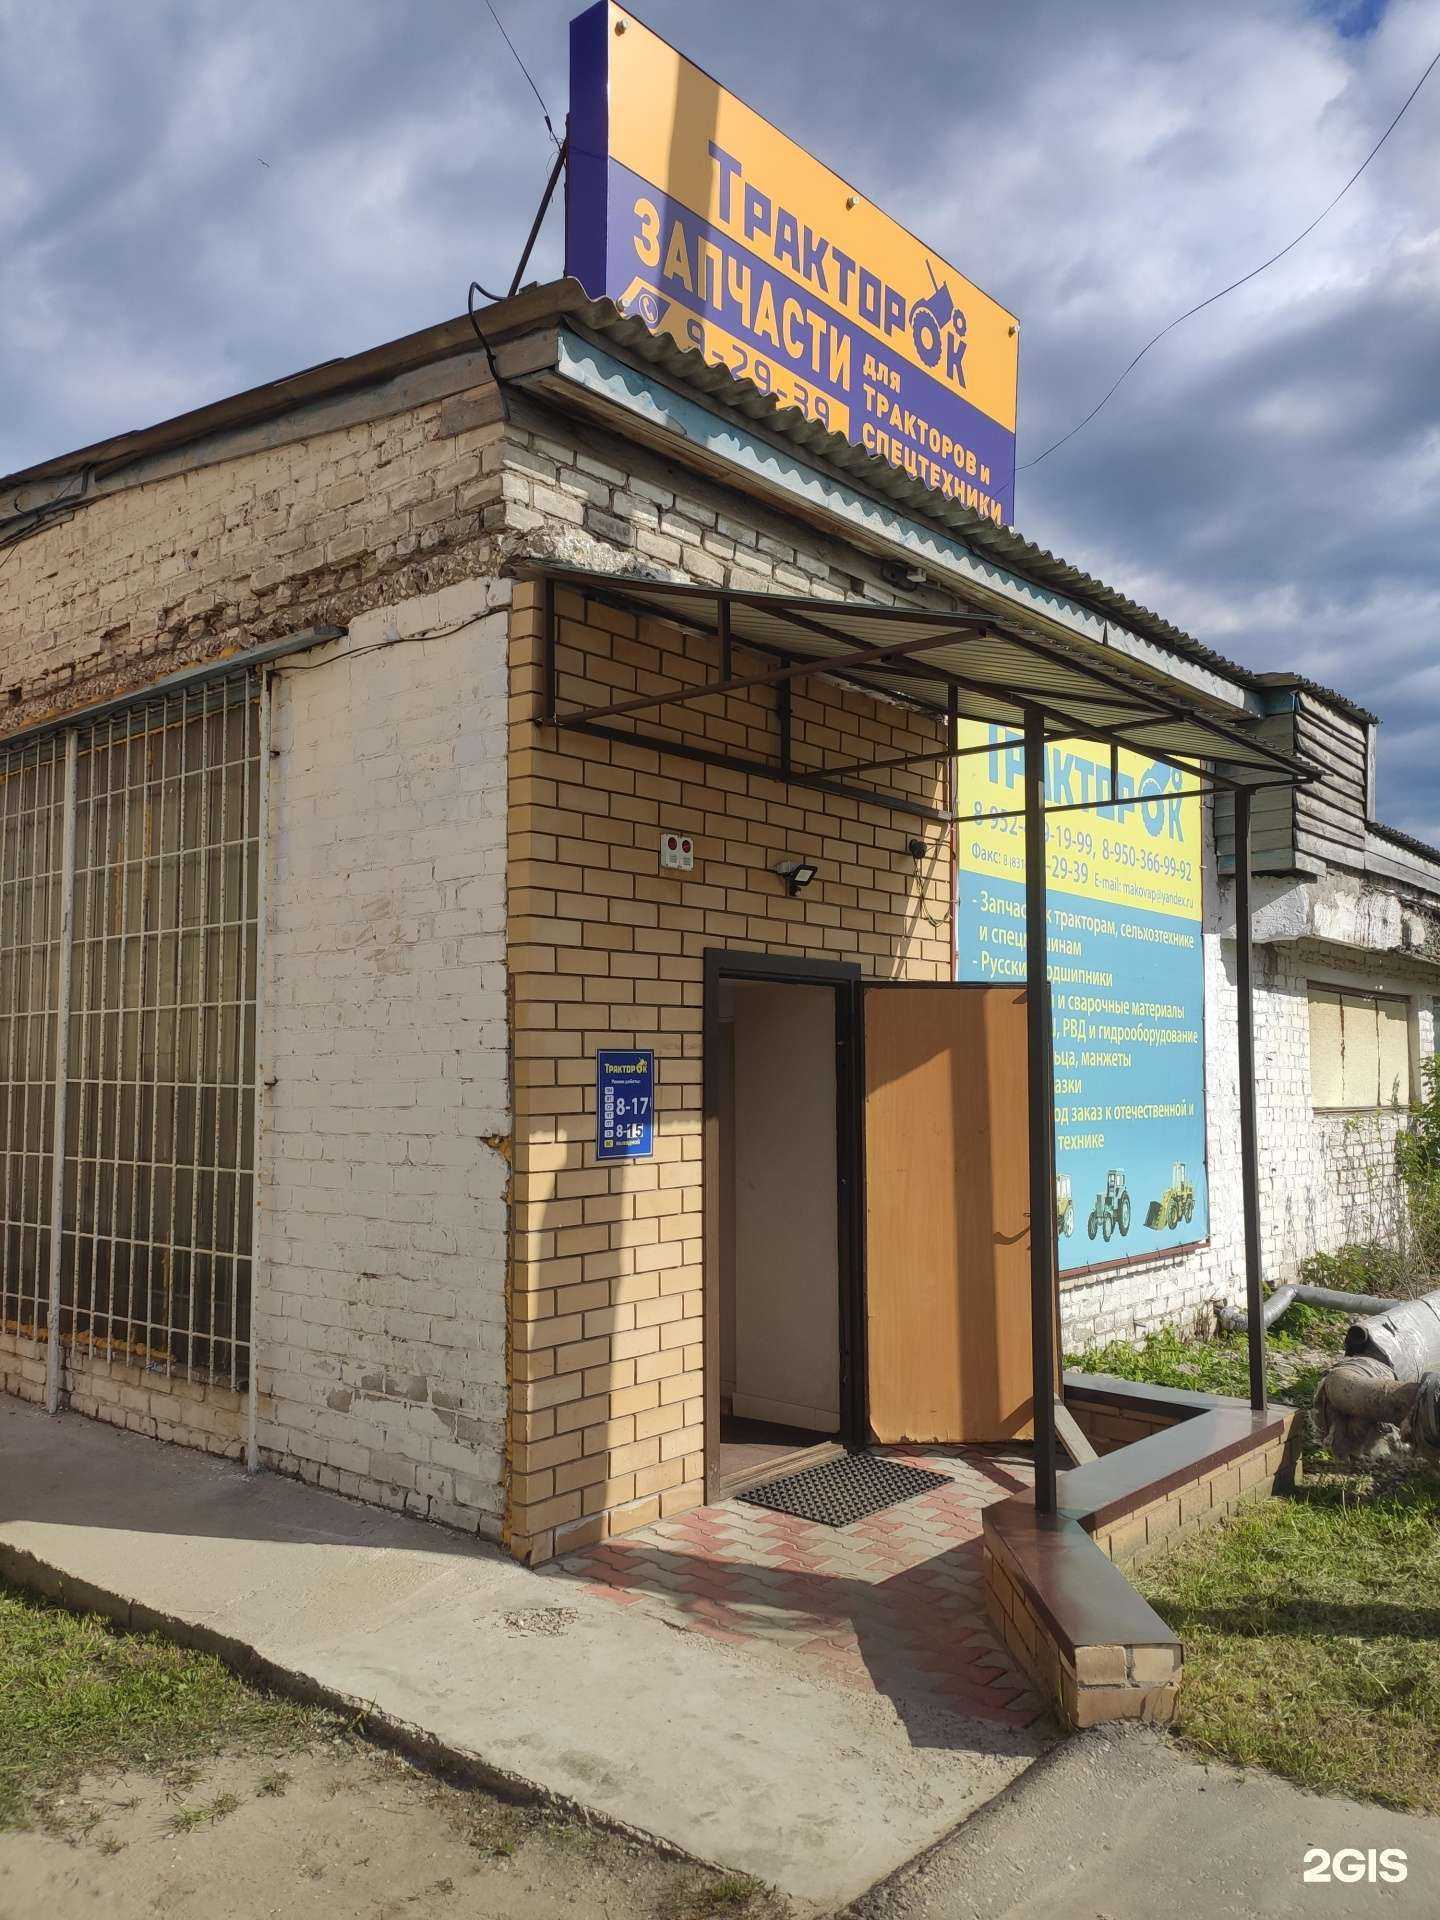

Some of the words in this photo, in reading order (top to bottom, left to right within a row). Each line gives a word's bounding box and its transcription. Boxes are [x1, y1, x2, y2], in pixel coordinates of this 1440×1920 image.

[633, 197, 851, 392] ЗАПЧАСТИ
[863, 383, 977, 476] ТРАКТОРОВ
[862, 422, 1002, 526] СПЕЦТЕХНИКИ
[972, 842, 1001, 864] Факс:
[1102, 838, 1192, 882] 8-950-366-99-92
[979, 925, 988, 942] и
[980, 889, 1027, 920] Запчас
[1054, 910, 1118, 938] тракторам,
[1120, 922, 1194, 949] сельхозтехнике
[981, 950, 1027, 979] Русски
[1047, 965, 1113, 987] одшипники
[1058, 993, 1066, 1009] и
[1068, 994, 1130, 1016] сварочные
[1131, 1001, 1185, 1023] материалы
[1063, 1018, 1087, 1043] РВД
[1089, 1024, 1096, 1039] и
[1098, 1022, 1199, 1047] гидрооборудование
[1081, 1051, 1132, 1068] манжеты
[616, 1097, 649, 1116] 8-17
[1071, 1106, 1103, 1122] заказ
[1105, 1106, 1113, 1121] к
[1114, 1098, 1187, 1120] отечественной
[1057, 1133, 1105, 1151] технике
